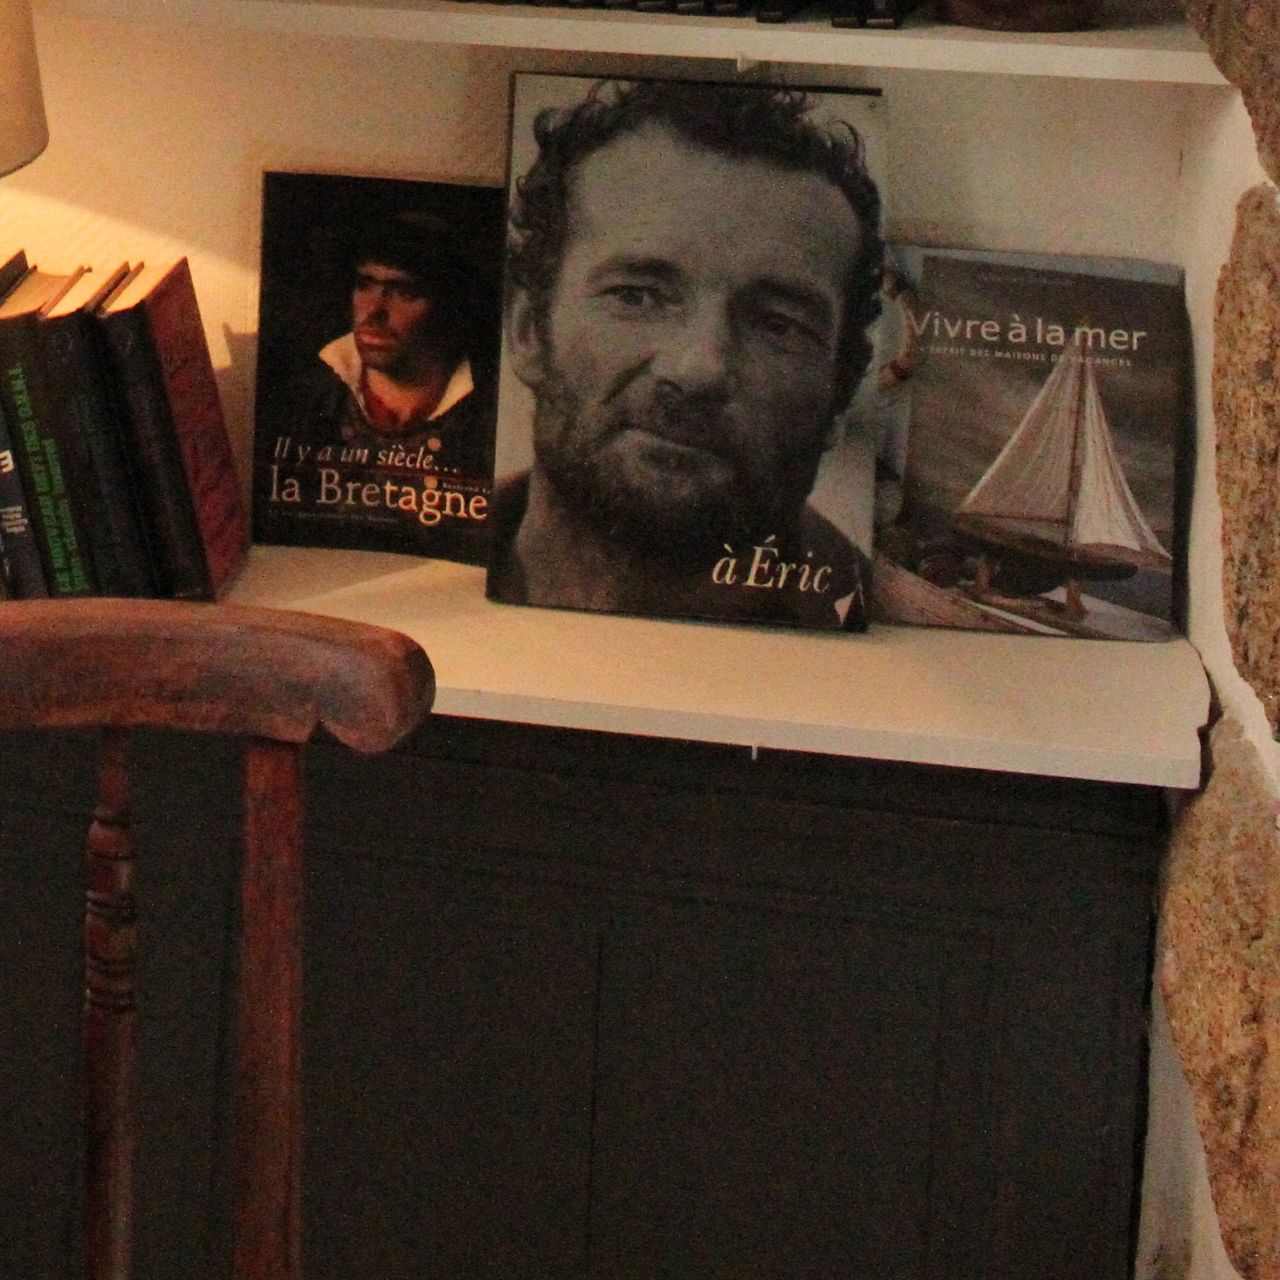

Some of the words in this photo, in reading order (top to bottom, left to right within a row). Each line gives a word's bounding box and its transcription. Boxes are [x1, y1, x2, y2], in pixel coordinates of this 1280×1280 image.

[912, 312, 1000, 340] Vivre
[1008, 314, 1027, 343] à
[1036, 318, 1065, 346] la
[1074, 325, 1147, 351] mer
[274, 436, 291, 458] Il
[297, 445, 311, 465] y
[317, 446, 332, 461] a
[340, 448, 369, 464] un
[270, 464, 301, 503] la
[316, 468, 488, 526] Bretagne
[712, 543, 737, 585] à
[743, 534, 833, 593] Éric
